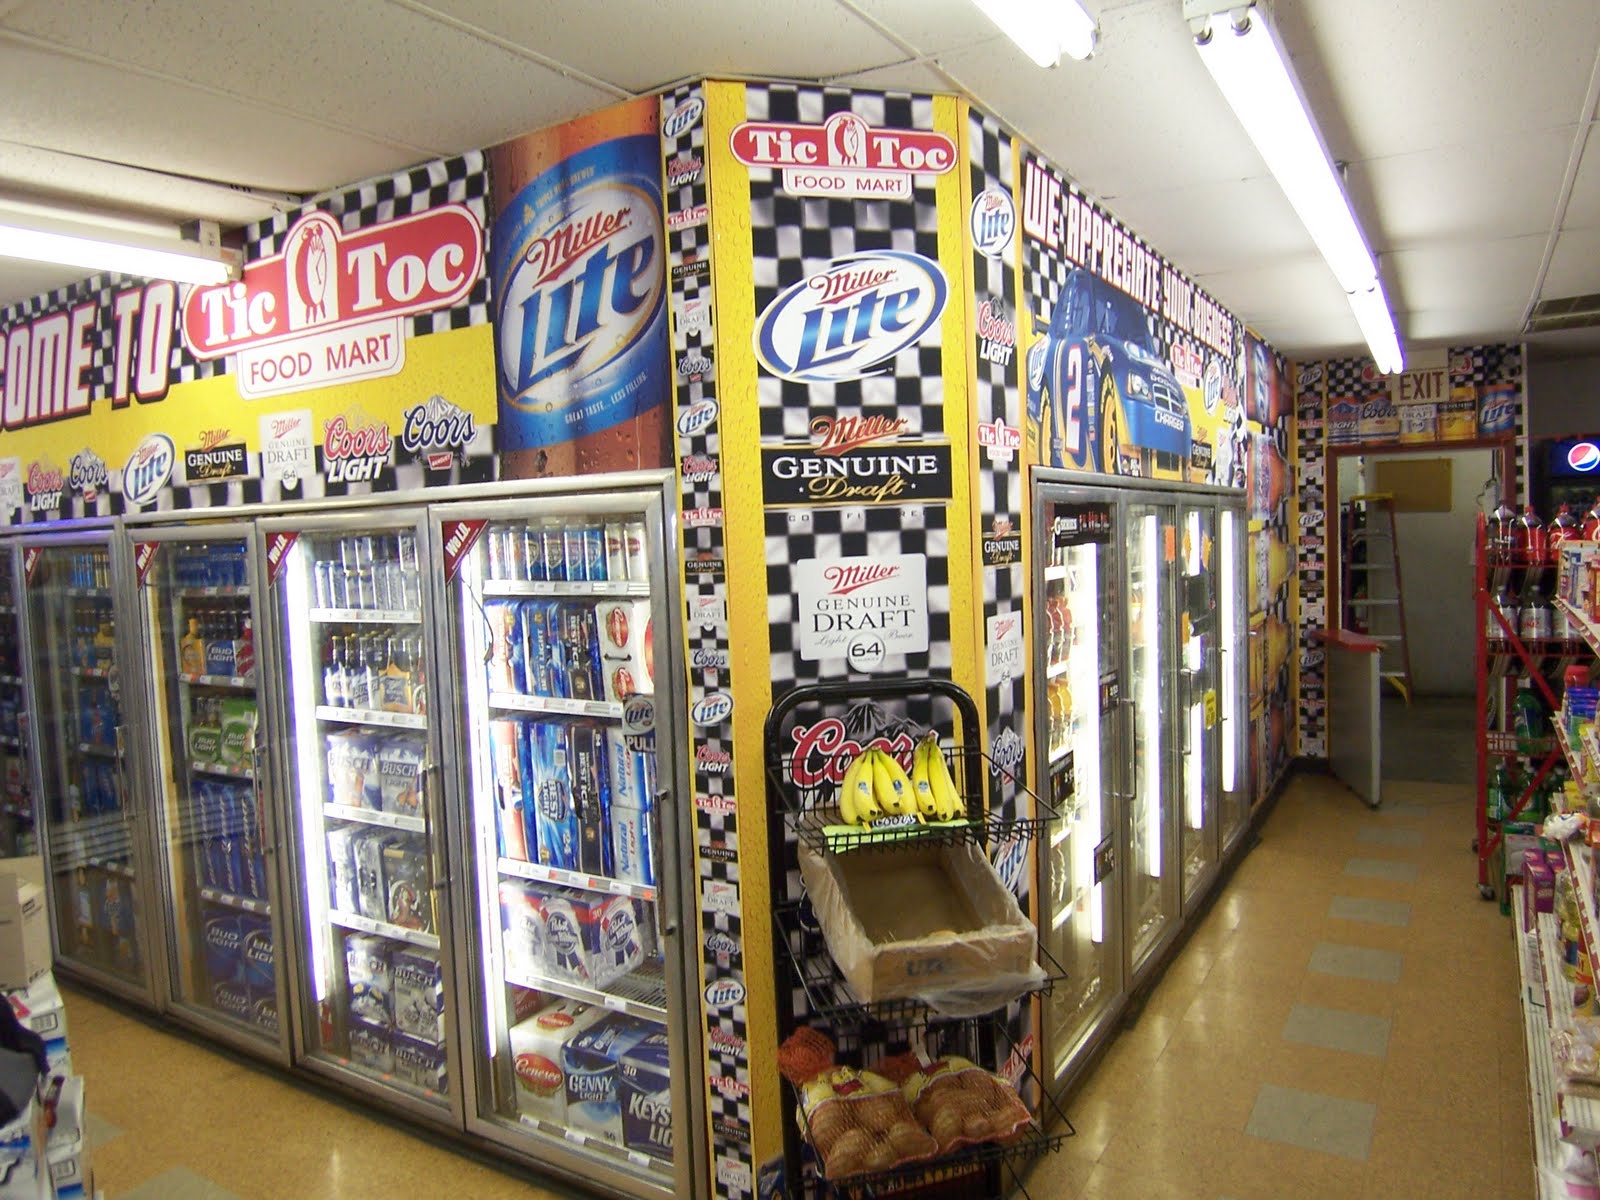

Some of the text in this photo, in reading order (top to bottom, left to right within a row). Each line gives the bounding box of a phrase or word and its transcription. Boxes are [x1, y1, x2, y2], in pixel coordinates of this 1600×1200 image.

[750, 130, 948, 169] Tic Toc
[671, 171, 700, 187] LIGHT
[794, 175, 903, 193] FOOD MART
[980, 211, 1010, 248] Lite
[525, 207, 632, 285] Miller
[1023, 159, 1232, 361] WE APPRECIATE YOUR BUSINESS
[201, 242, 465, 347] Tic Toc
[808, 267, 897, 305] Miller
[515, 240, 656, 392] Lite
[979, 302, 1015, 347] Coors
[791, 286, 920, 375] Lite
[0, 280, 175, 430] OME TO
[249, 333, 392, 386] FOOD MART
[980, 338, 1013, 367] LIGHT
[678, 357, 712, 377] Coors
[1065, 344, 1082, 454] 2
[1399, 371, 1444, 401] EXIT
[402, 405, 476, 450] Coors
[1155, 410, 1185, 432] CHARGER
[324, 416, 392, 460] Coors
[810, 414, 909, 456] Miller
[979, 426, 995, 445] Tic
[187, 450, 243, 467] GENUINE
[267, 448, 310, 464] DRAFT
[771, 455, 938, 480] GENUINE
[27, 463, 64, 495] Coors
[70, 455, 108, 489] Coors
[133, 450, 167, 501] Lite
[328, 456, 388, 483] LIGHT
[686, 471, 715, 484] LIGHT
[807, 475, 904, 502] Draft
[31, 492, 63, 512] LIGHT
[984, 539, 1020, 554] GENUINE
[824, 564, 900, 593] Miller
[816, 595, 911, 612] GENUINE
[813, 609, 916, 633] DRAFT
[693, 650, 726, 667] Coors
[851, 642, 882, 657] 64
[991, 647, 1020, 667] DRAFT
[700, 702, 728, 723] Lite
[382, 760, 418, 778] BUSCH
[699, 761, 729, 773] LIGHT
[706, 934, 739, 954] Coors
[569, 1074, 613, 1093] GENNY
[623, 1063, 638, 1078] 30
[580, 1092, 604, 1101] LIGHT
